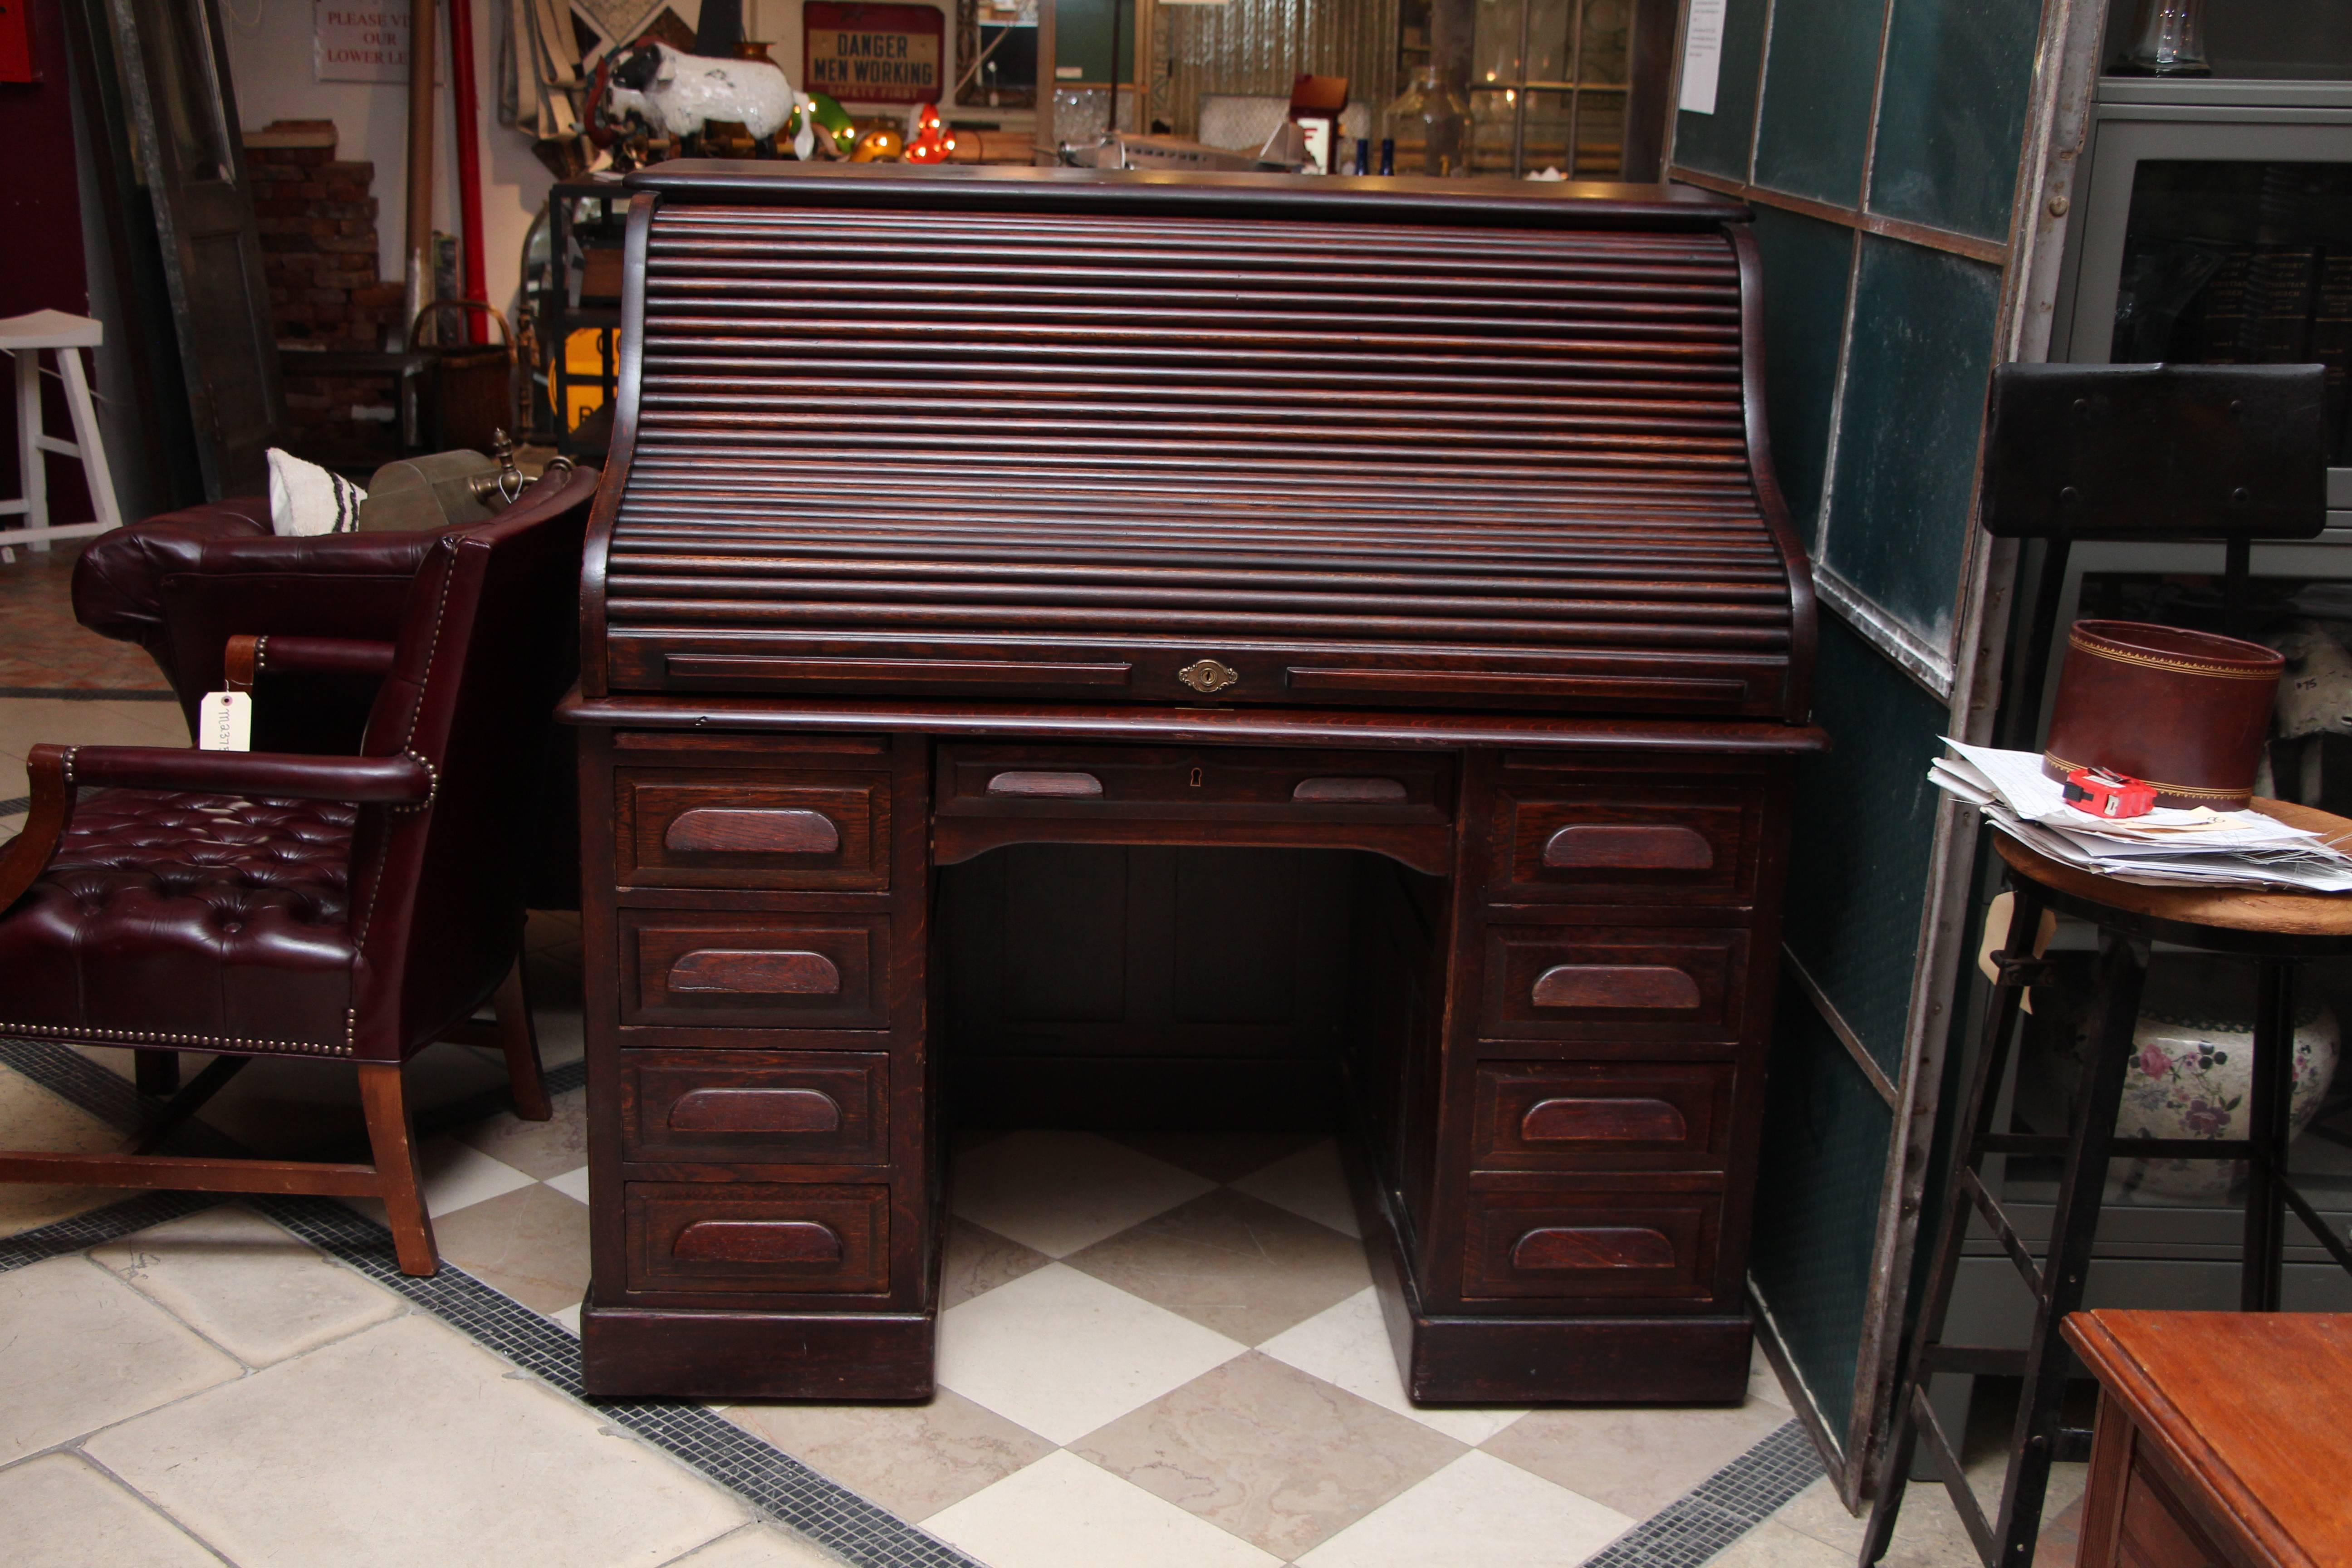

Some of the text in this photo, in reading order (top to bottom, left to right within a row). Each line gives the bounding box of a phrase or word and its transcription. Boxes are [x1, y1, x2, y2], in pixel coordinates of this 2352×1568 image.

[327, 11, 386, 26] PLEASE
[363, 32, 397, 46] OUR
[837, 33, 908, 59] DANGER
[327, 49, 385, 65] LOWER
[814, 58, 933, 85] MEN WORKING
